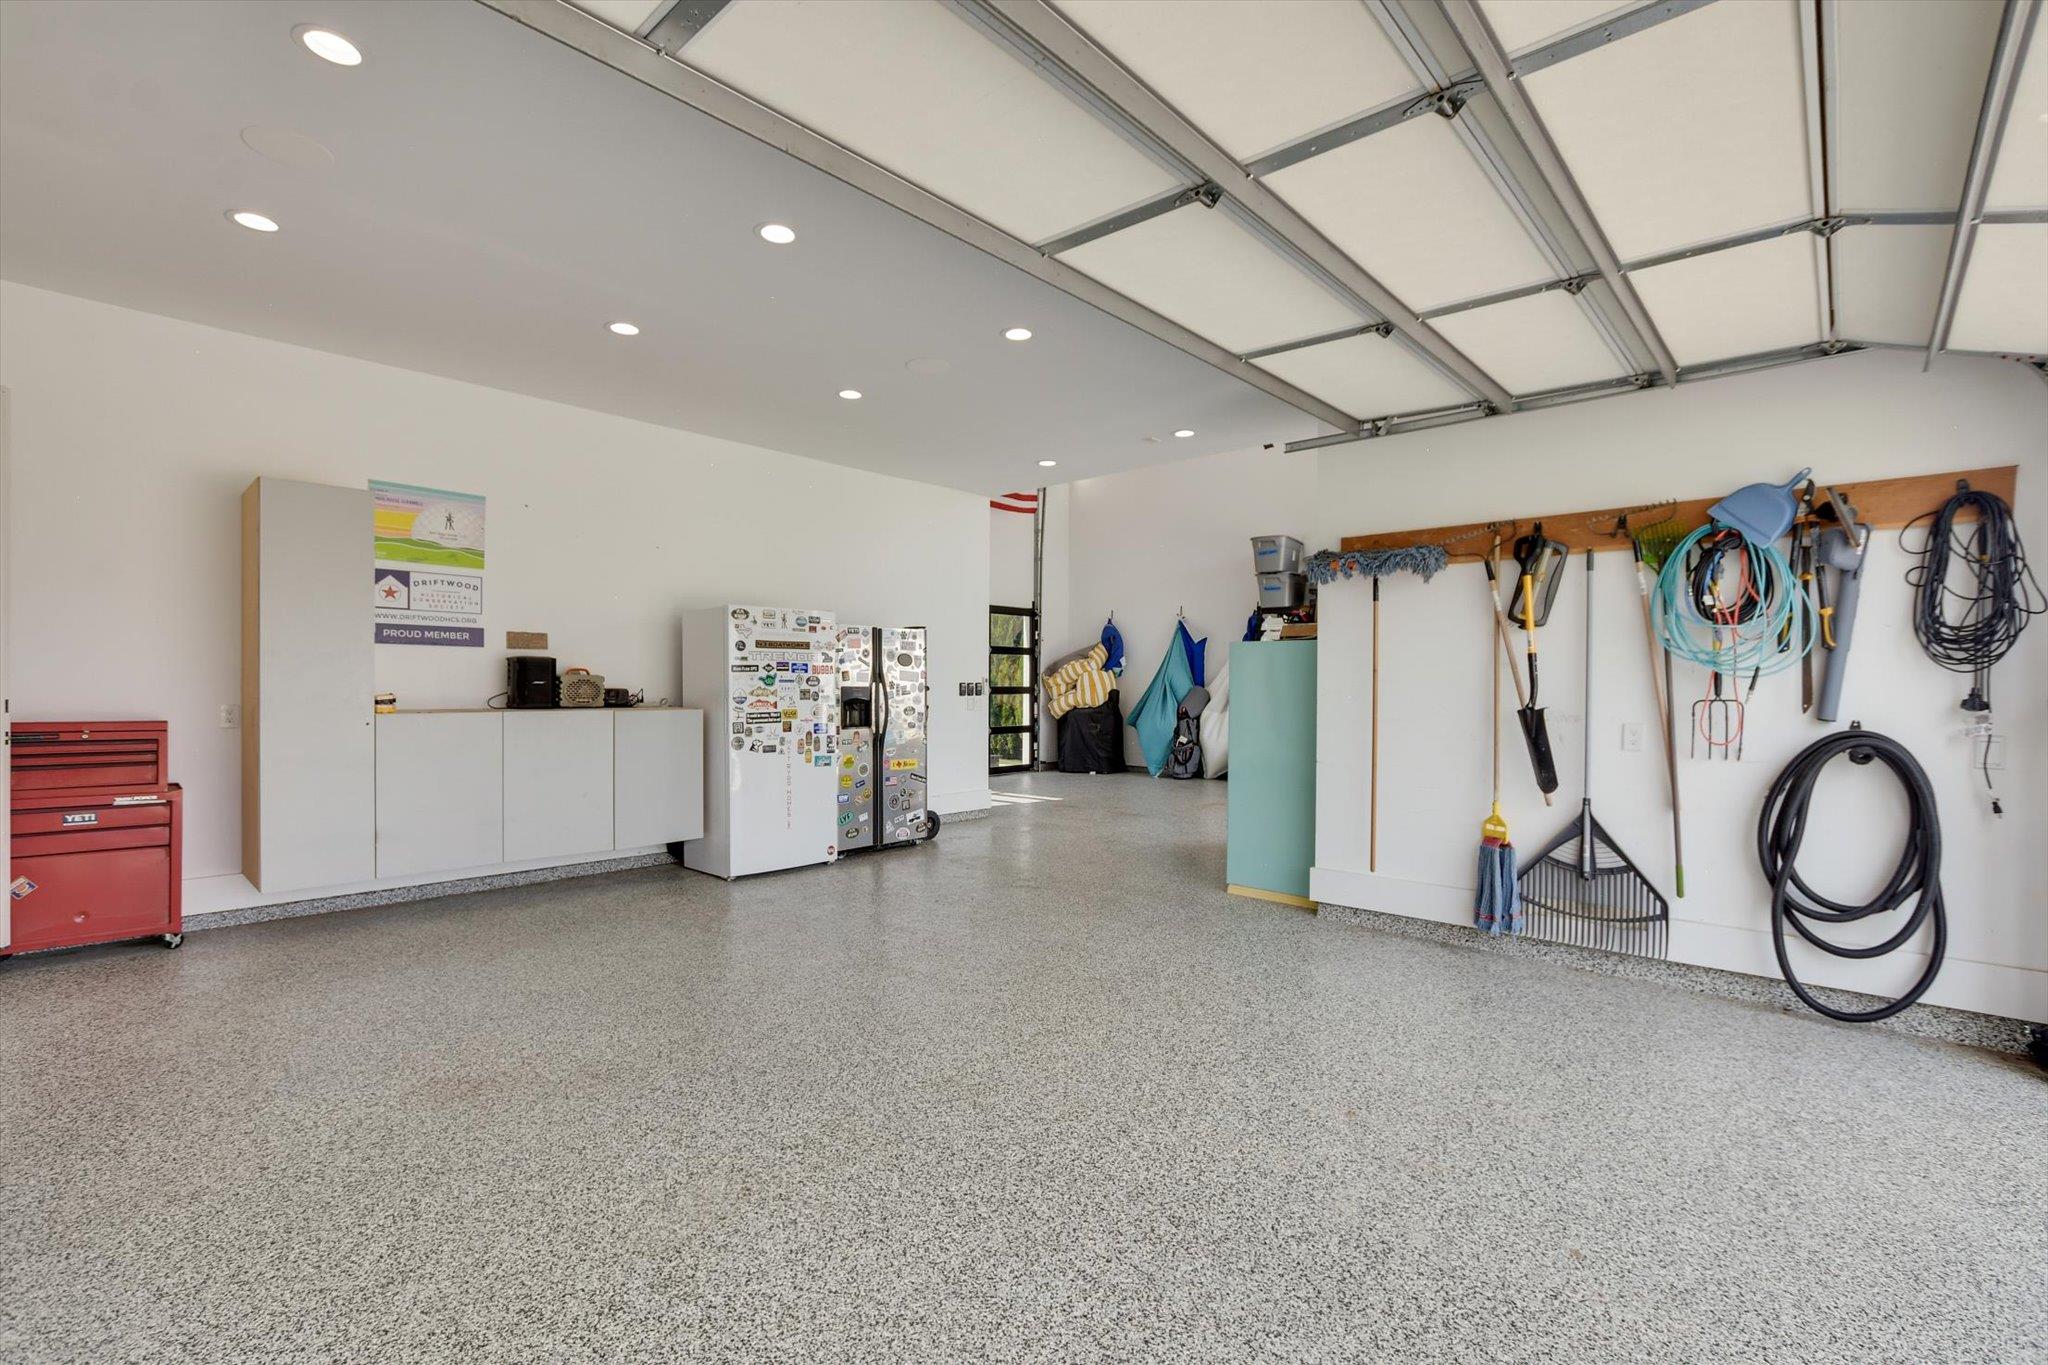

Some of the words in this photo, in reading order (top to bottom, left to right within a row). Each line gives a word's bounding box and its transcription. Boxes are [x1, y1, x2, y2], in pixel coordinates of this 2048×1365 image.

[413, 580, 479, 591] DRIFTWOOD
[413, 598, 479, 606] CONSERVATION
[375, 613, 477, 623] WWW.DRIFTWOODHCS.ORG
[383, 629, 422, 638] PROUD
[424, 631, 470, 640] MEMBER
[65, 814, 95, 822] YETI
